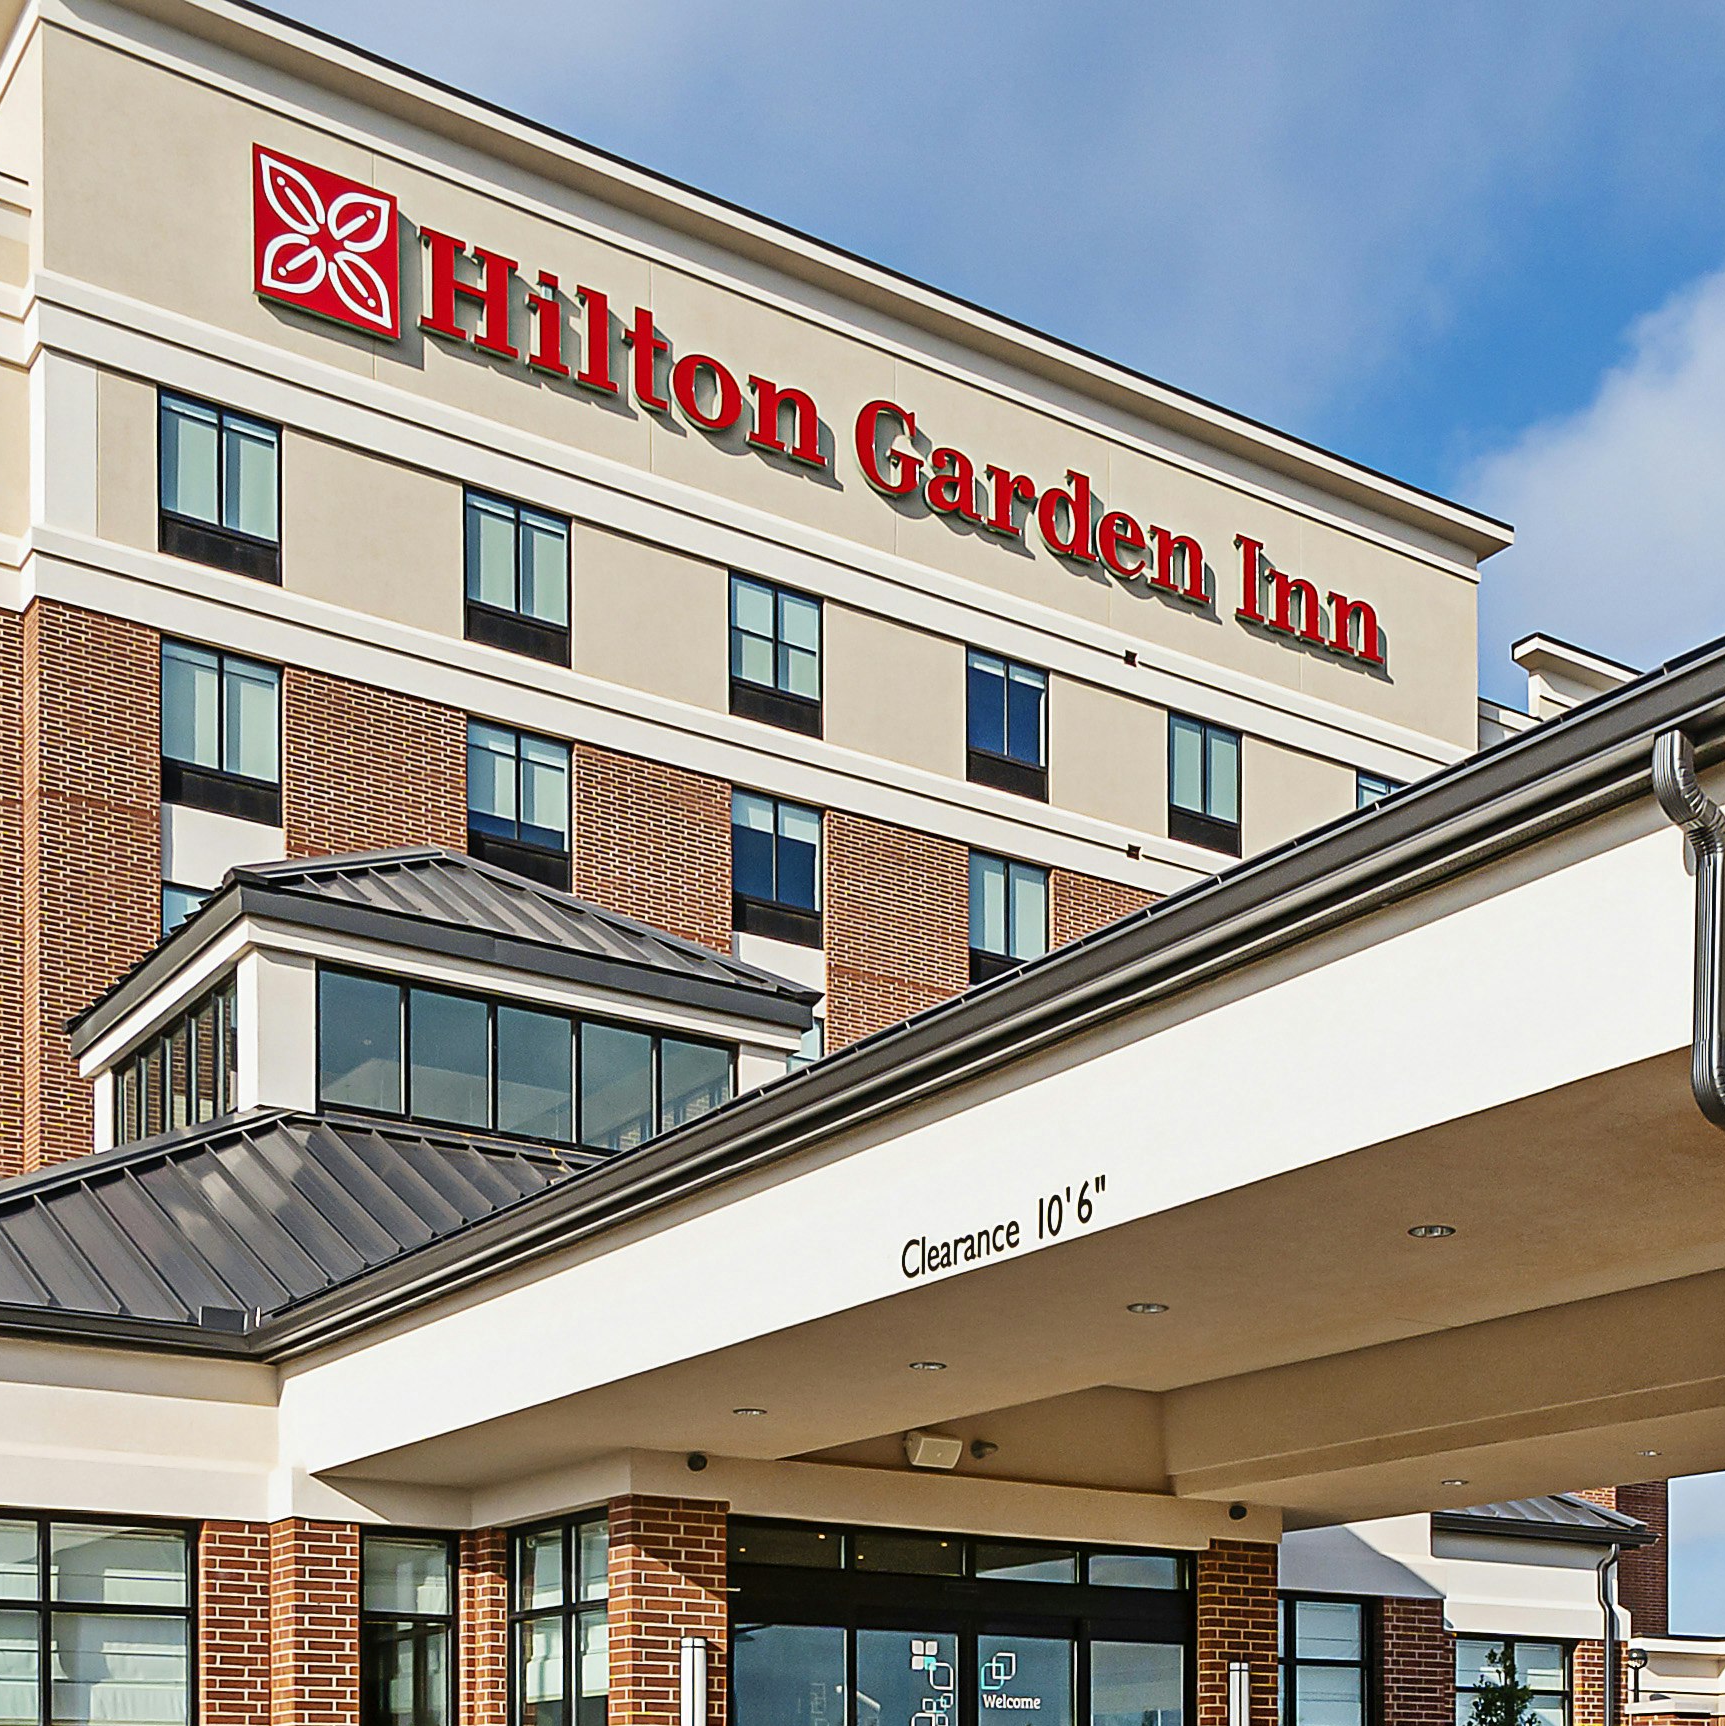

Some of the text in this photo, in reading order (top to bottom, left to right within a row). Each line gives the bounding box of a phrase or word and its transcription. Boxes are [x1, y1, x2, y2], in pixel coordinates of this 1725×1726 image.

[419, 226, 1387, 666] Hilton Garden Inn
[901, 1219, 1021, 1279] Clearance
[982, 1693, 1041, 1710] Welcome
